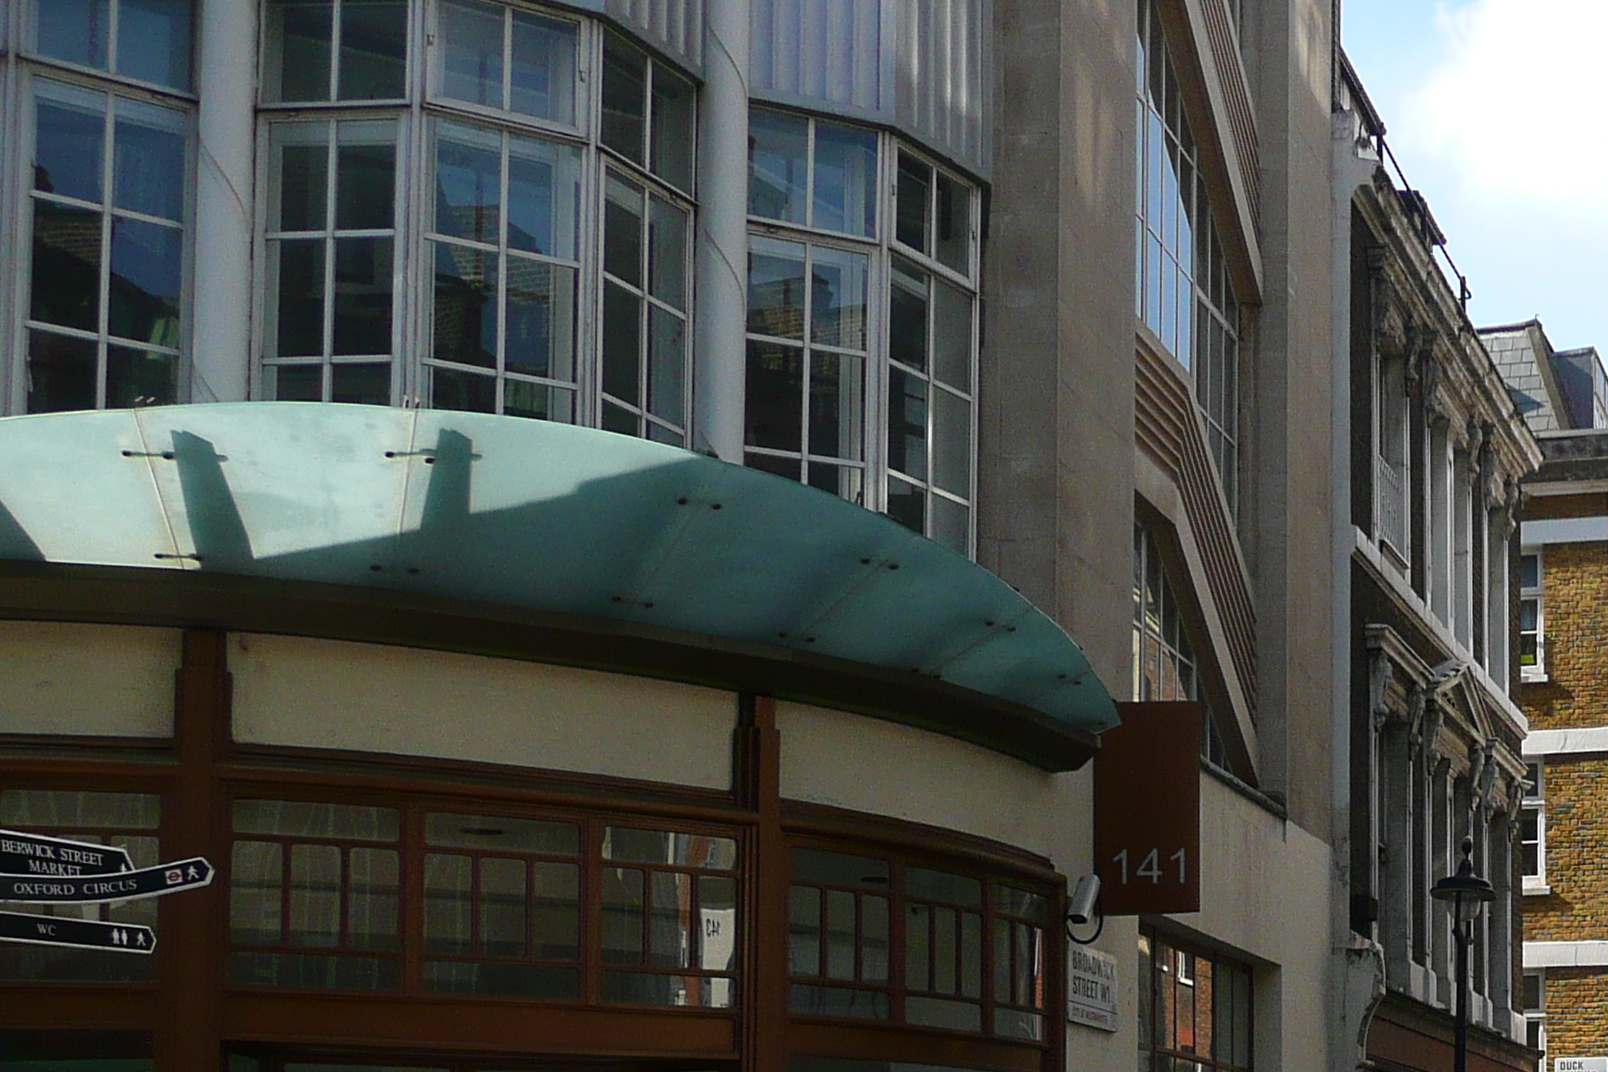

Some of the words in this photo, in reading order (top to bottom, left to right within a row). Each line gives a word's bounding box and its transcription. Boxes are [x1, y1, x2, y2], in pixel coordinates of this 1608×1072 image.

[1, 839, 56, 859] BERWICK
[60, 847, 104, 866] STREET
[29, 860, 82, 876] MARKET
[1112, 847, 1187, 885] 141
[14, 882, 75, 896] OXFORD
[82, 879, 137, 895] CIRCUS
[37, 923, 57, 937] WC
[1072, 975, 1099, 1000] STREET
[1560, 1061, 1584, 1071] DUCK
